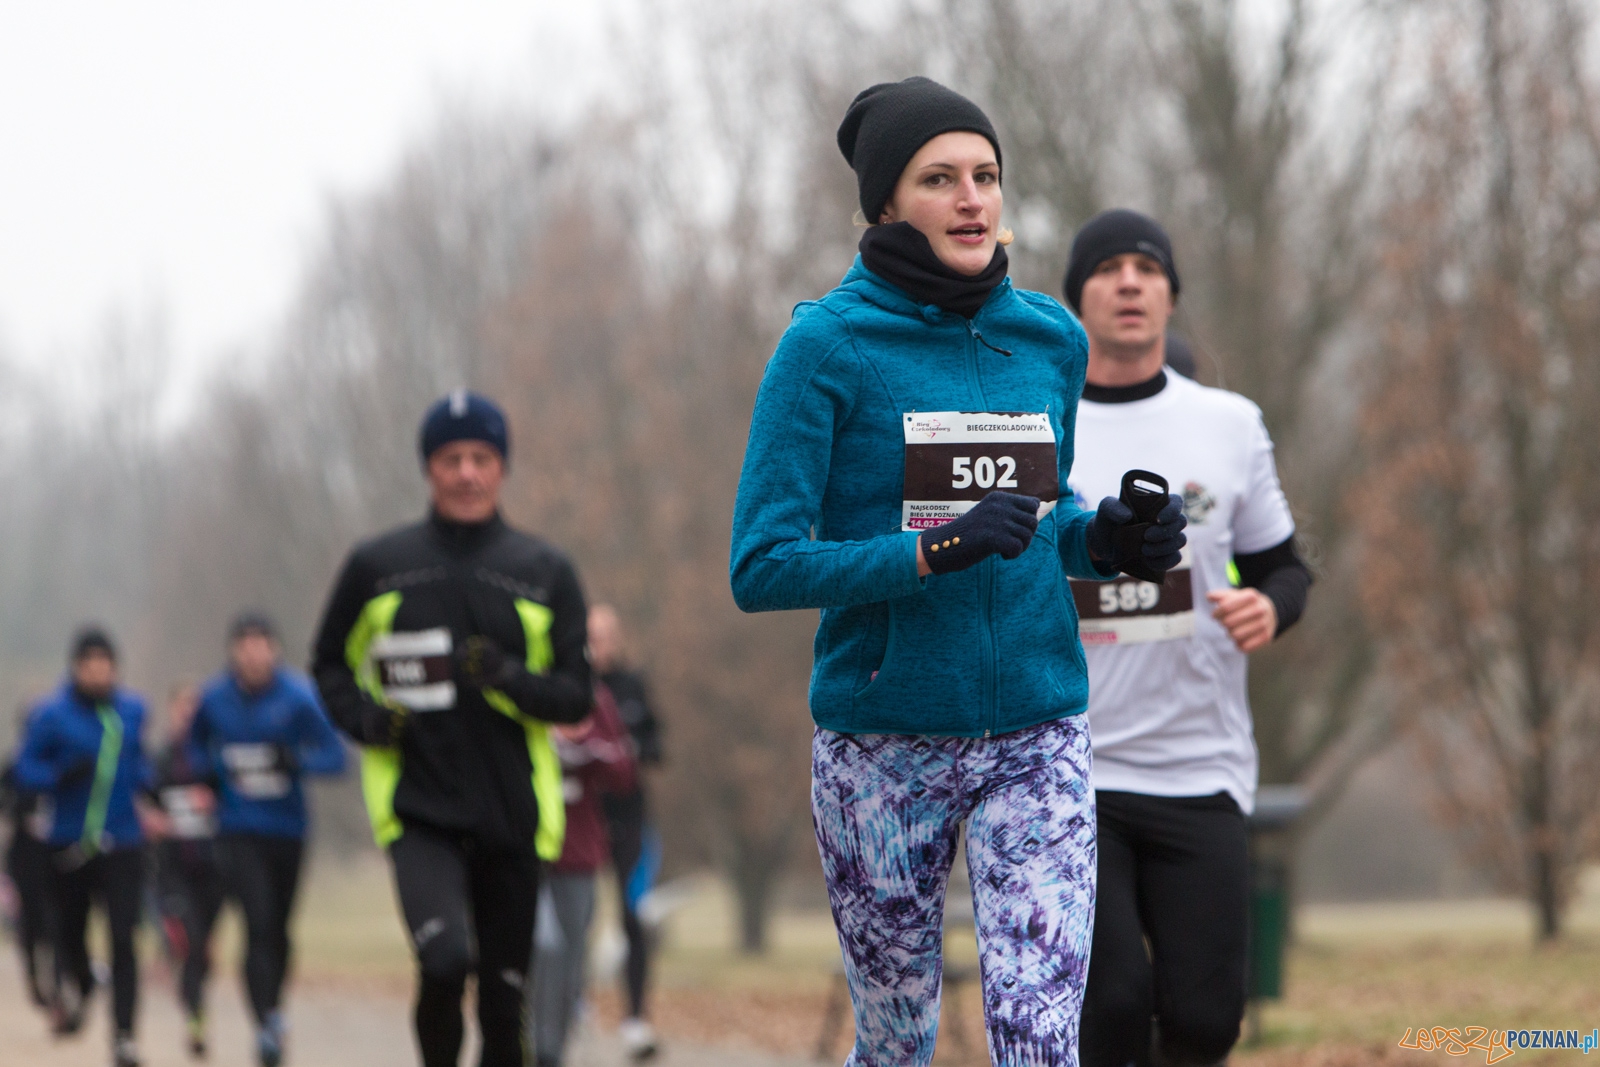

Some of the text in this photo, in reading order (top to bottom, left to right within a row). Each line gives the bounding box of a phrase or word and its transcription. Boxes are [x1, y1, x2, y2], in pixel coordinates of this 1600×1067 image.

[966, 424, 1048, 432] BIEGCZEKOLADOWY.PL
[951, 456, 1018, 489] 502
[1099, 581, 1160, 613] 589
